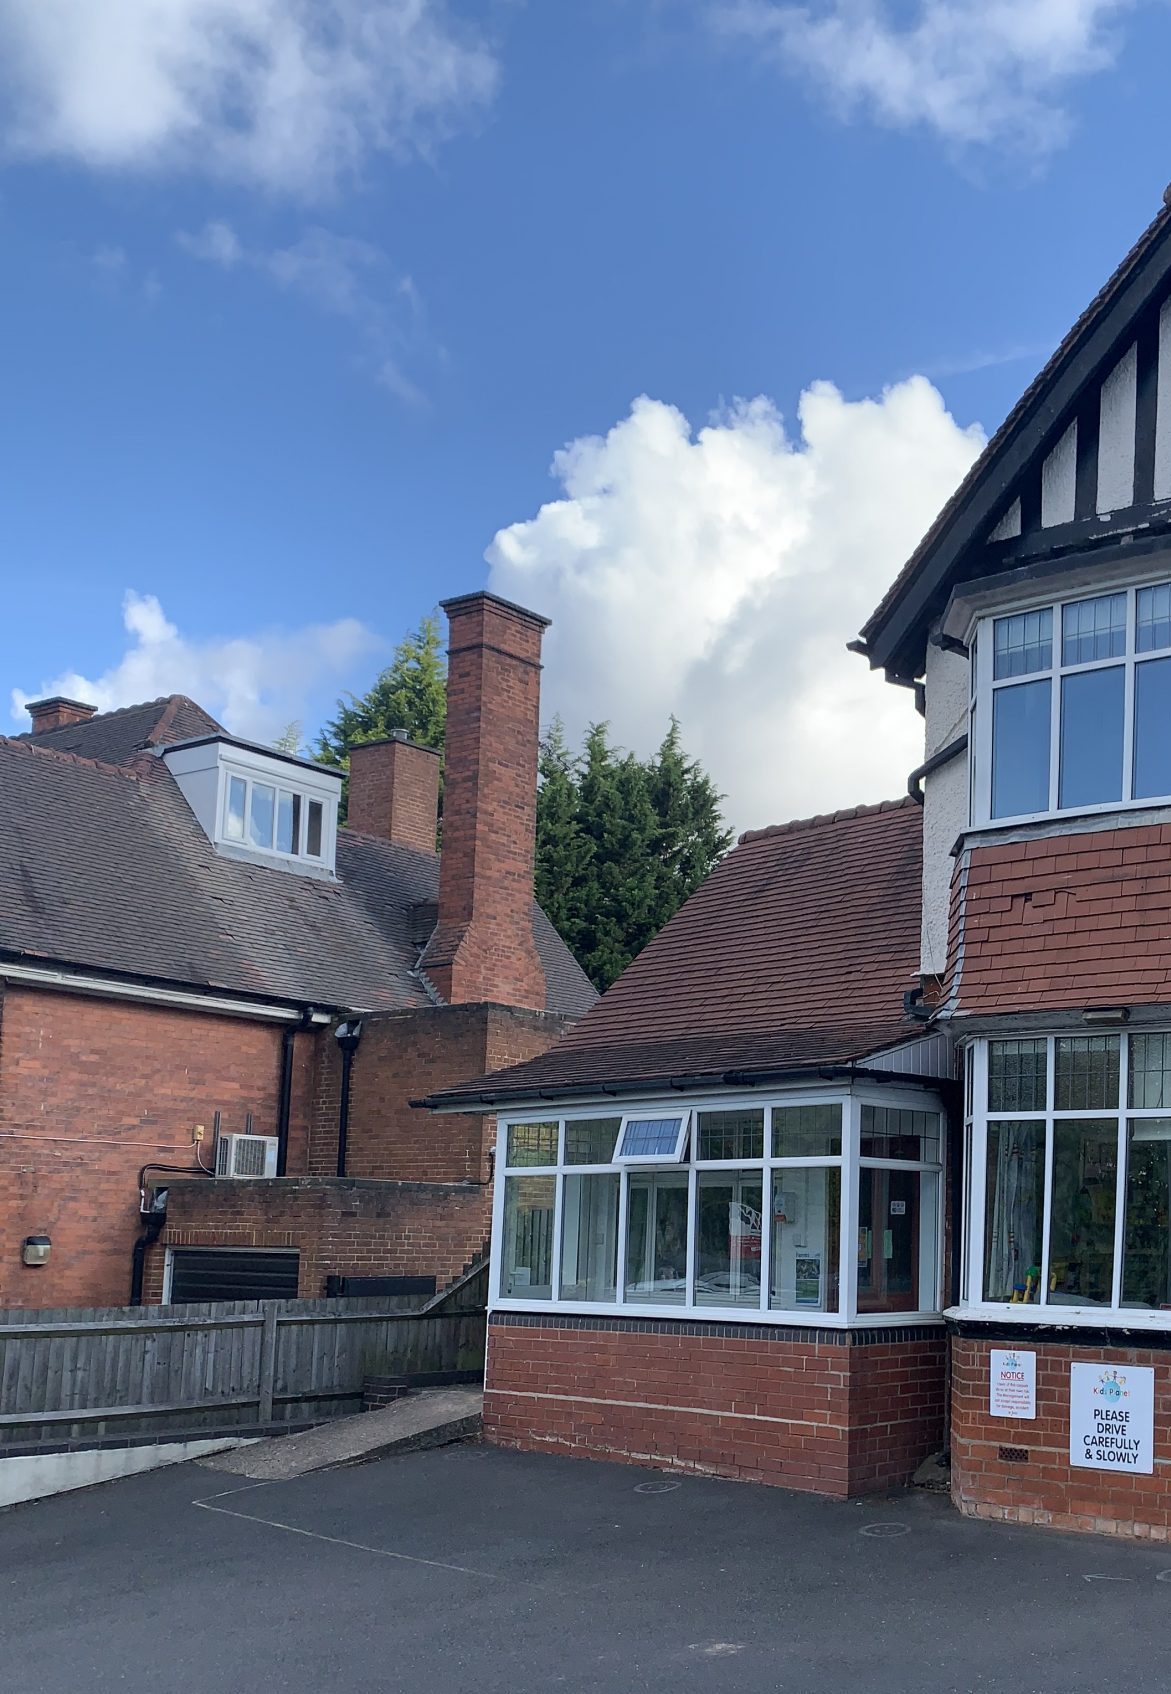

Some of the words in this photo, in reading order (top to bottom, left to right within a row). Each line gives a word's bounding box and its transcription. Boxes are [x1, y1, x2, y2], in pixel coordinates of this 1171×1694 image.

[1094, 1409, 1130, 1422] PLEASE
[1097, 1423, 1126, 1435] DRIVE
[1084, 1435, 1140, 1450] CAREFULLY
[1085, 1449, 1092, 1459] &
[1096, 1450, 1138, 1464] SLOWLY
